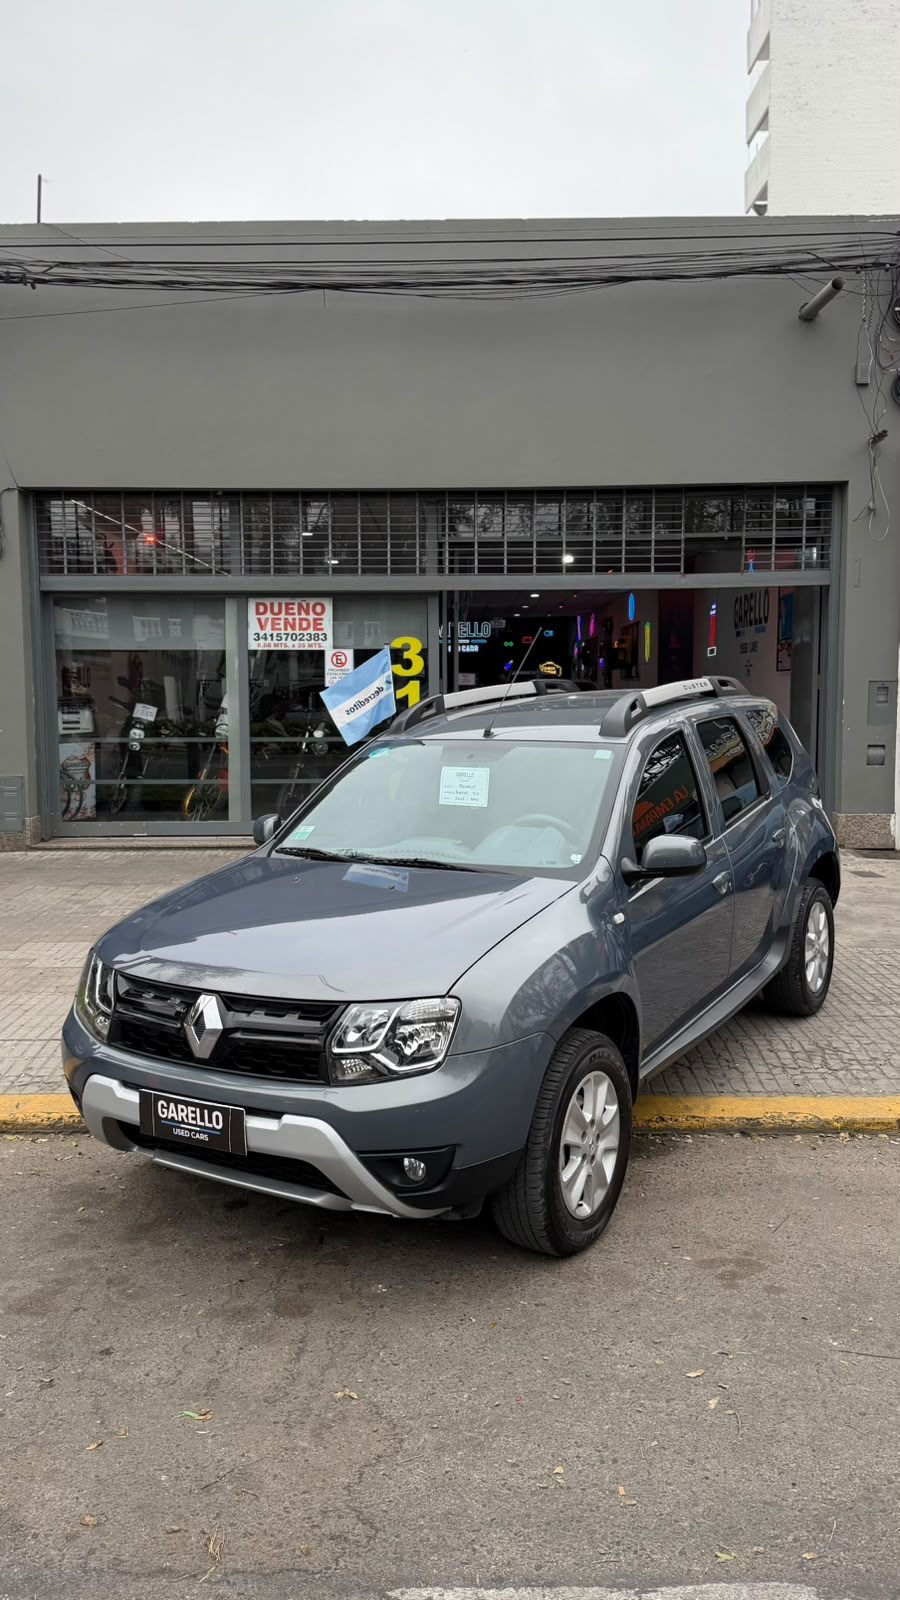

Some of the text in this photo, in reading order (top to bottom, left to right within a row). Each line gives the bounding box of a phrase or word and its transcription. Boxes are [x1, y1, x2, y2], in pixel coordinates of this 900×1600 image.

[255, 600, 326, 616] DUEÑO
[733, 588, 770, 630] GARELLO
[256, 617, 324, 631] VENDE
[253, 632, 328, 642] 3415702383
[682, 681, 708, 690] DUSTER
[157, 1100, 223, 1130] GARELLO
[172, 1127, 209, 1142] USED CARS
